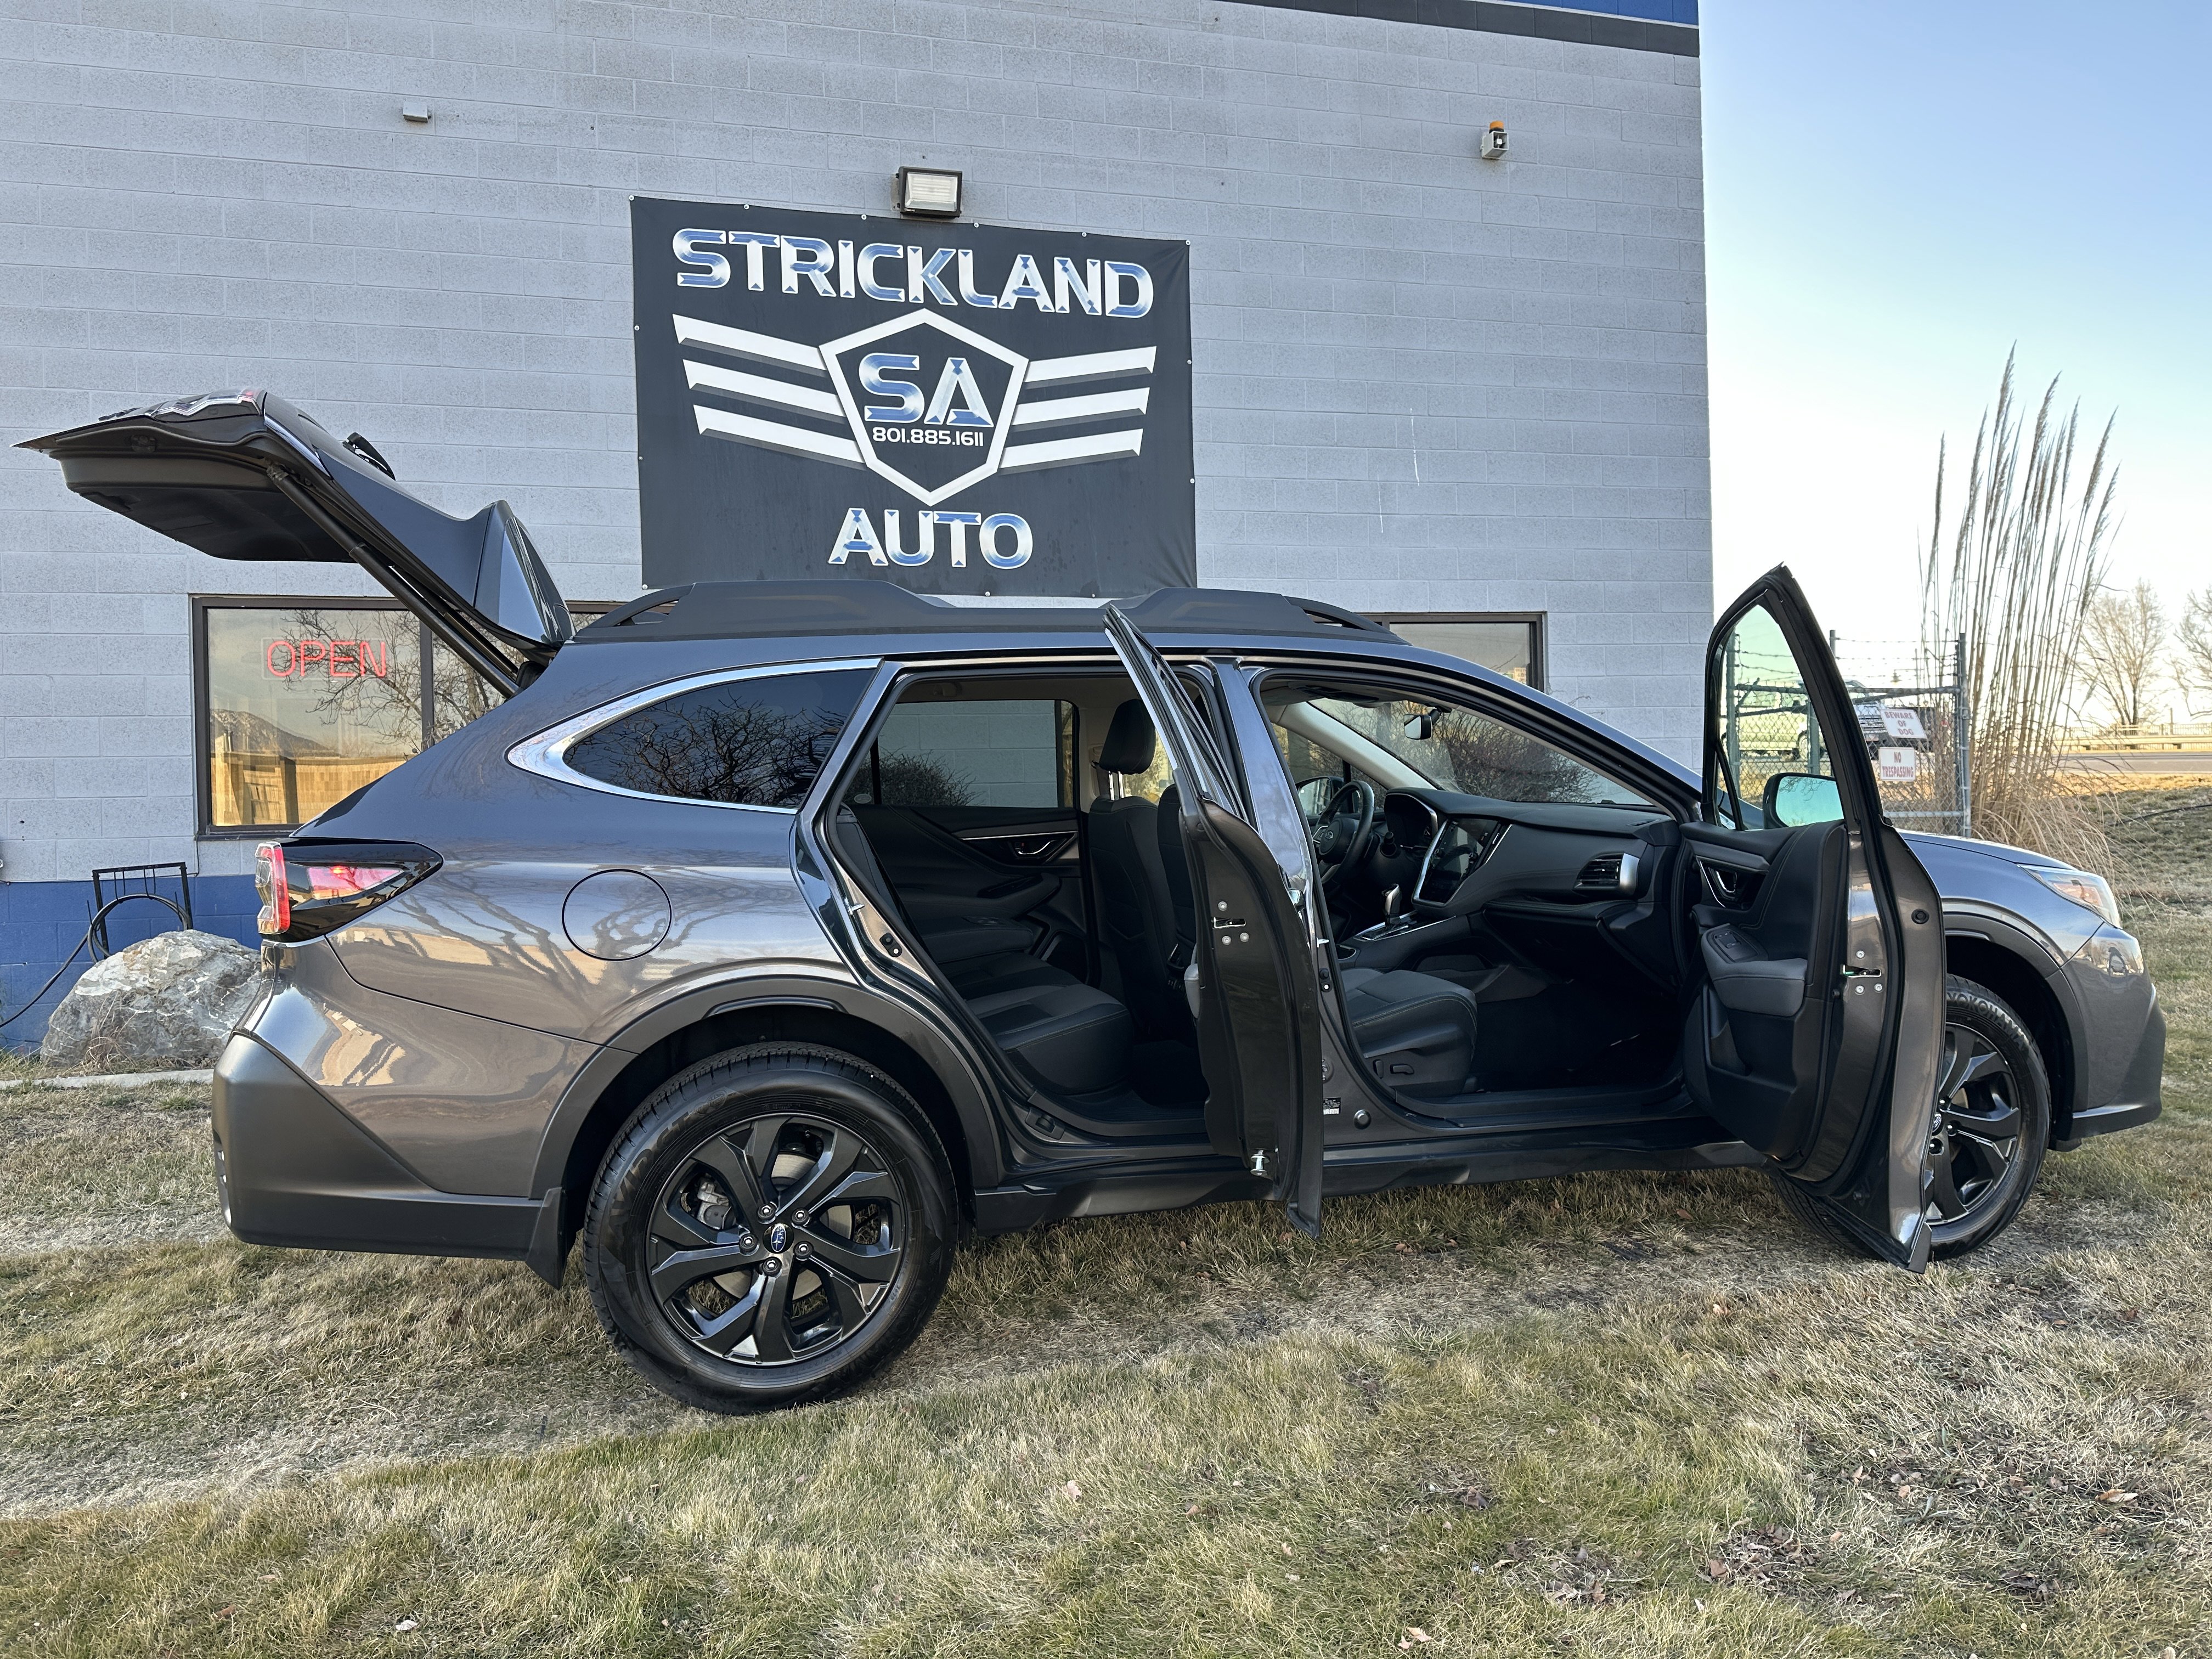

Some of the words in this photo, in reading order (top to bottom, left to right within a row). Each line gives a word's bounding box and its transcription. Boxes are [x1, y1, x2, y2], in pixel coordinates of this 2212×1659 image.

[672, 228, 1154, 318] STRICKLAND
[858, 352, 994, 427] SA
[872, 427, 984, 447] 801.885.1611
[828, 507, 1033, 569] AUTO
[267, 640, 387, 677] OPEN
[1884, 712, 1914, 720] BEWARE
[1882, 766, 1914, 778] TRESPASSING
[1894, 752, 1901, 763] NO
[1947, 992, 2028, 1051] YOKOHAMA
